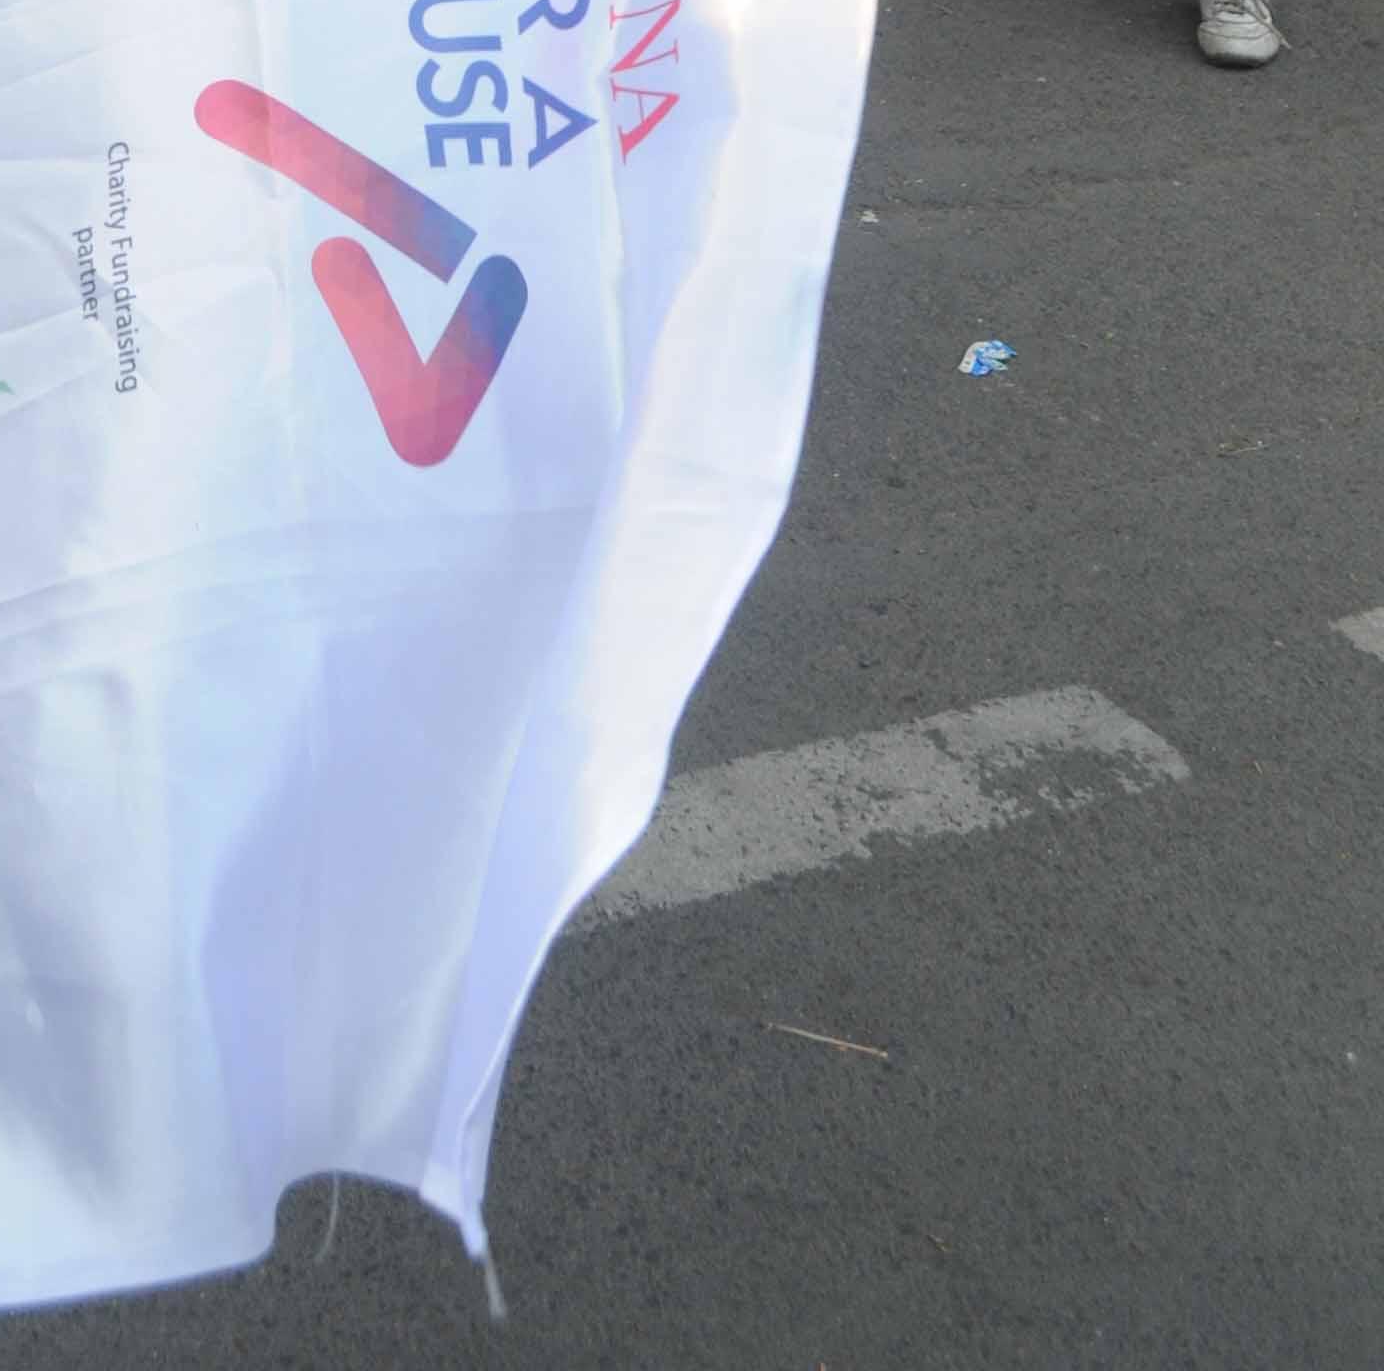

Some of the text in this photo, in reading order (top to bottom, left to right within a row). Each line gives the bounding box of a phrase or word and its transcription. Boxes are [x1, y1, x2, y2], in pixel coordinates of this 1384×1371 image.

[521, 75, 599, 170] A
[72, 226, 99, 322] partner
[105, 141, 138, 394] Charity Fundraising
